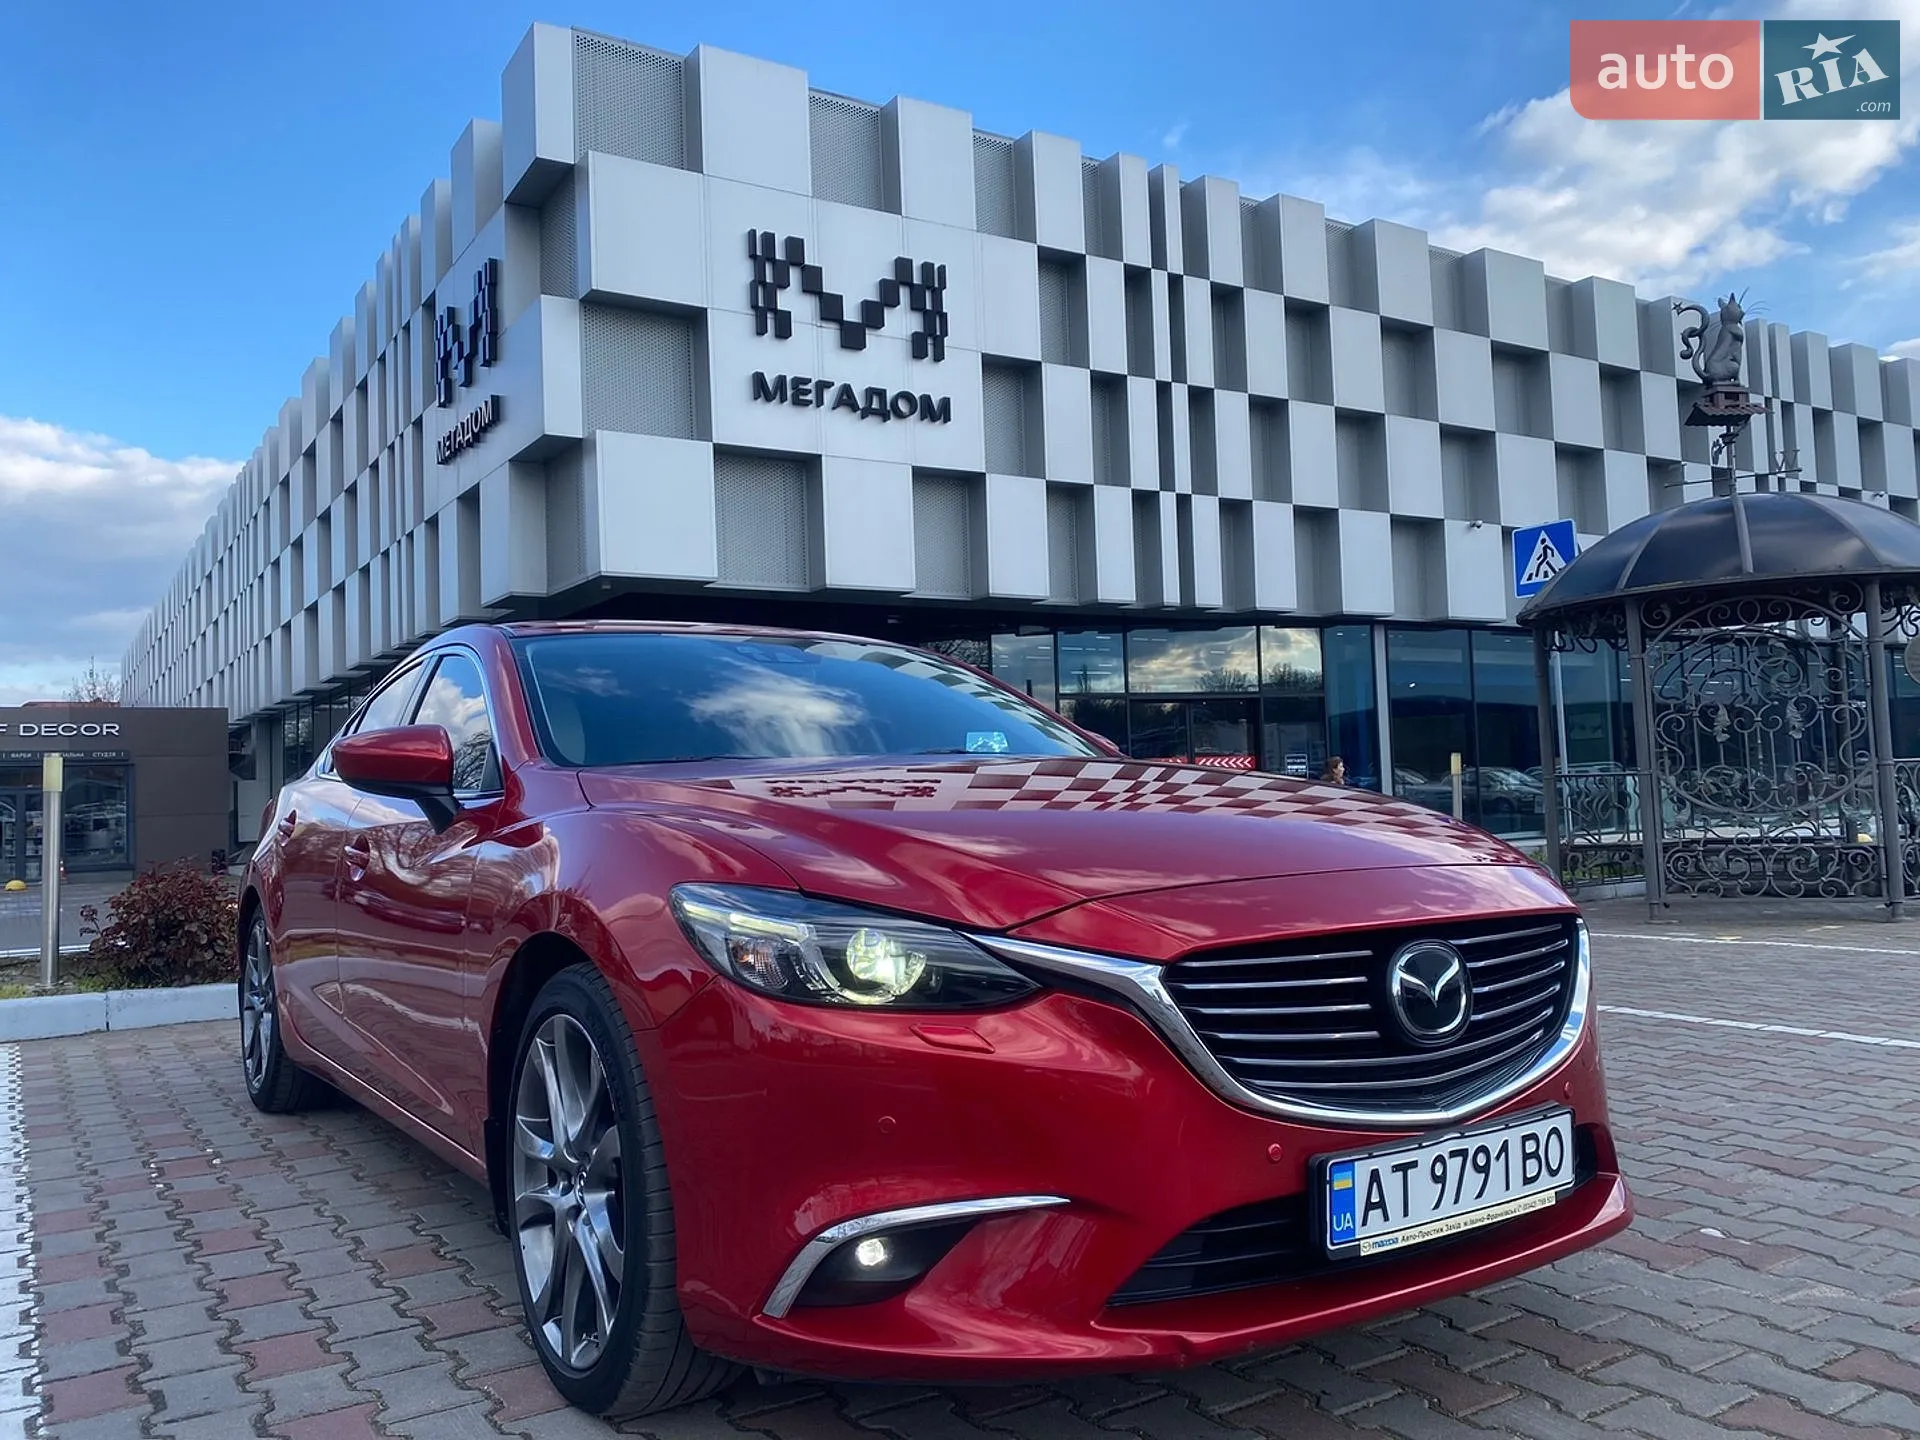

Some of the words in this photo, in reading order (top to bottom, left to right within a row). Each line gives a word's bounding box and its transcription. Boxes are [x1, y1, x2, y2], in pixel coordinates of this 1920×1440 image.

[752, 370, 952, 425] МЕГАДОМ
[436, 394, 500, 465] МЕГАДОМ
[19, 723, 120, 736] DECOR
[1333, 1213, 1354, 1232] UA
[1361, 1160, 1419, 1227] AT
[1430, 1139, 1511, 1211] 9791
[1521, 1126, 1564, 1187] BO
[1372, 1237, 1399, 1249] mazda
